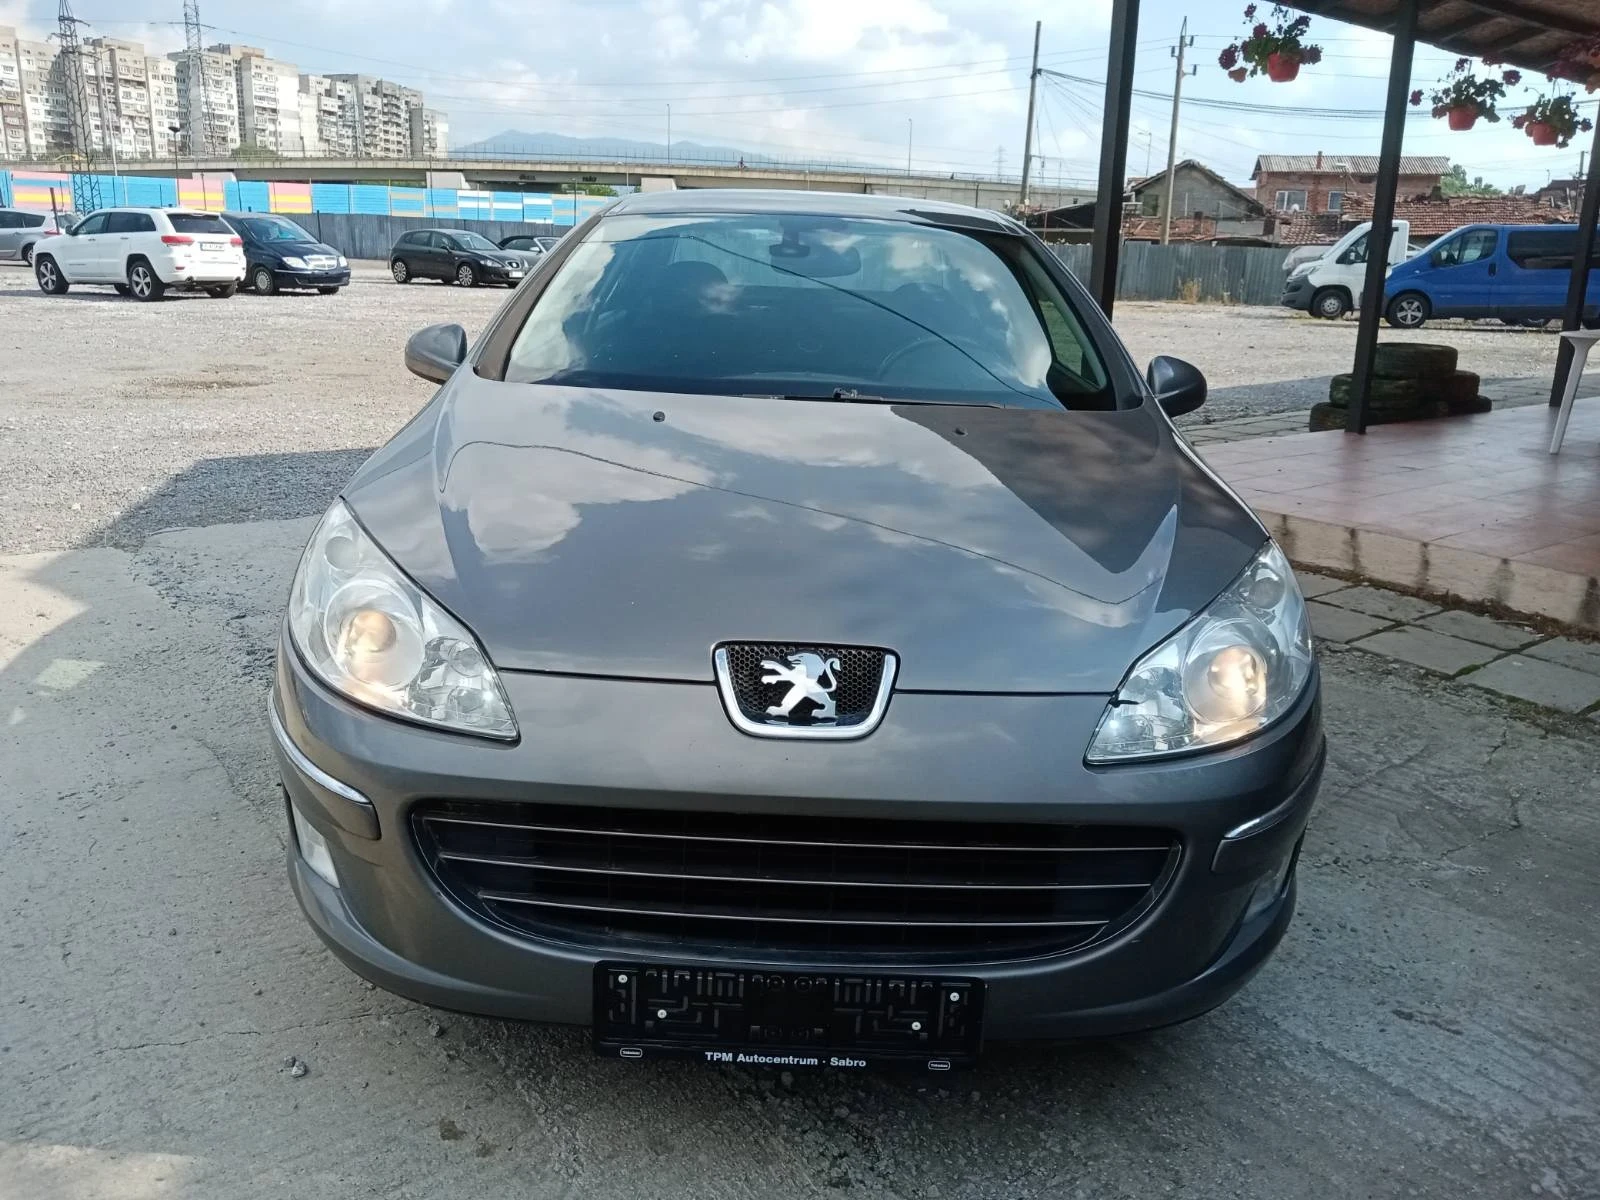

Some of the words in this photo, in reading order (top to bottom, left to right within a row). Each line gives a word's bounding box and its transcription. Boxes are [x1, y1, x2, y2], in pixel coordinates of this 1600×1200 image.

[704, 1051, 733, 1061] TPM
[736, 1053, 818, 1065] Autocentrum
[830, 1057, 867, 1067] Sabro
